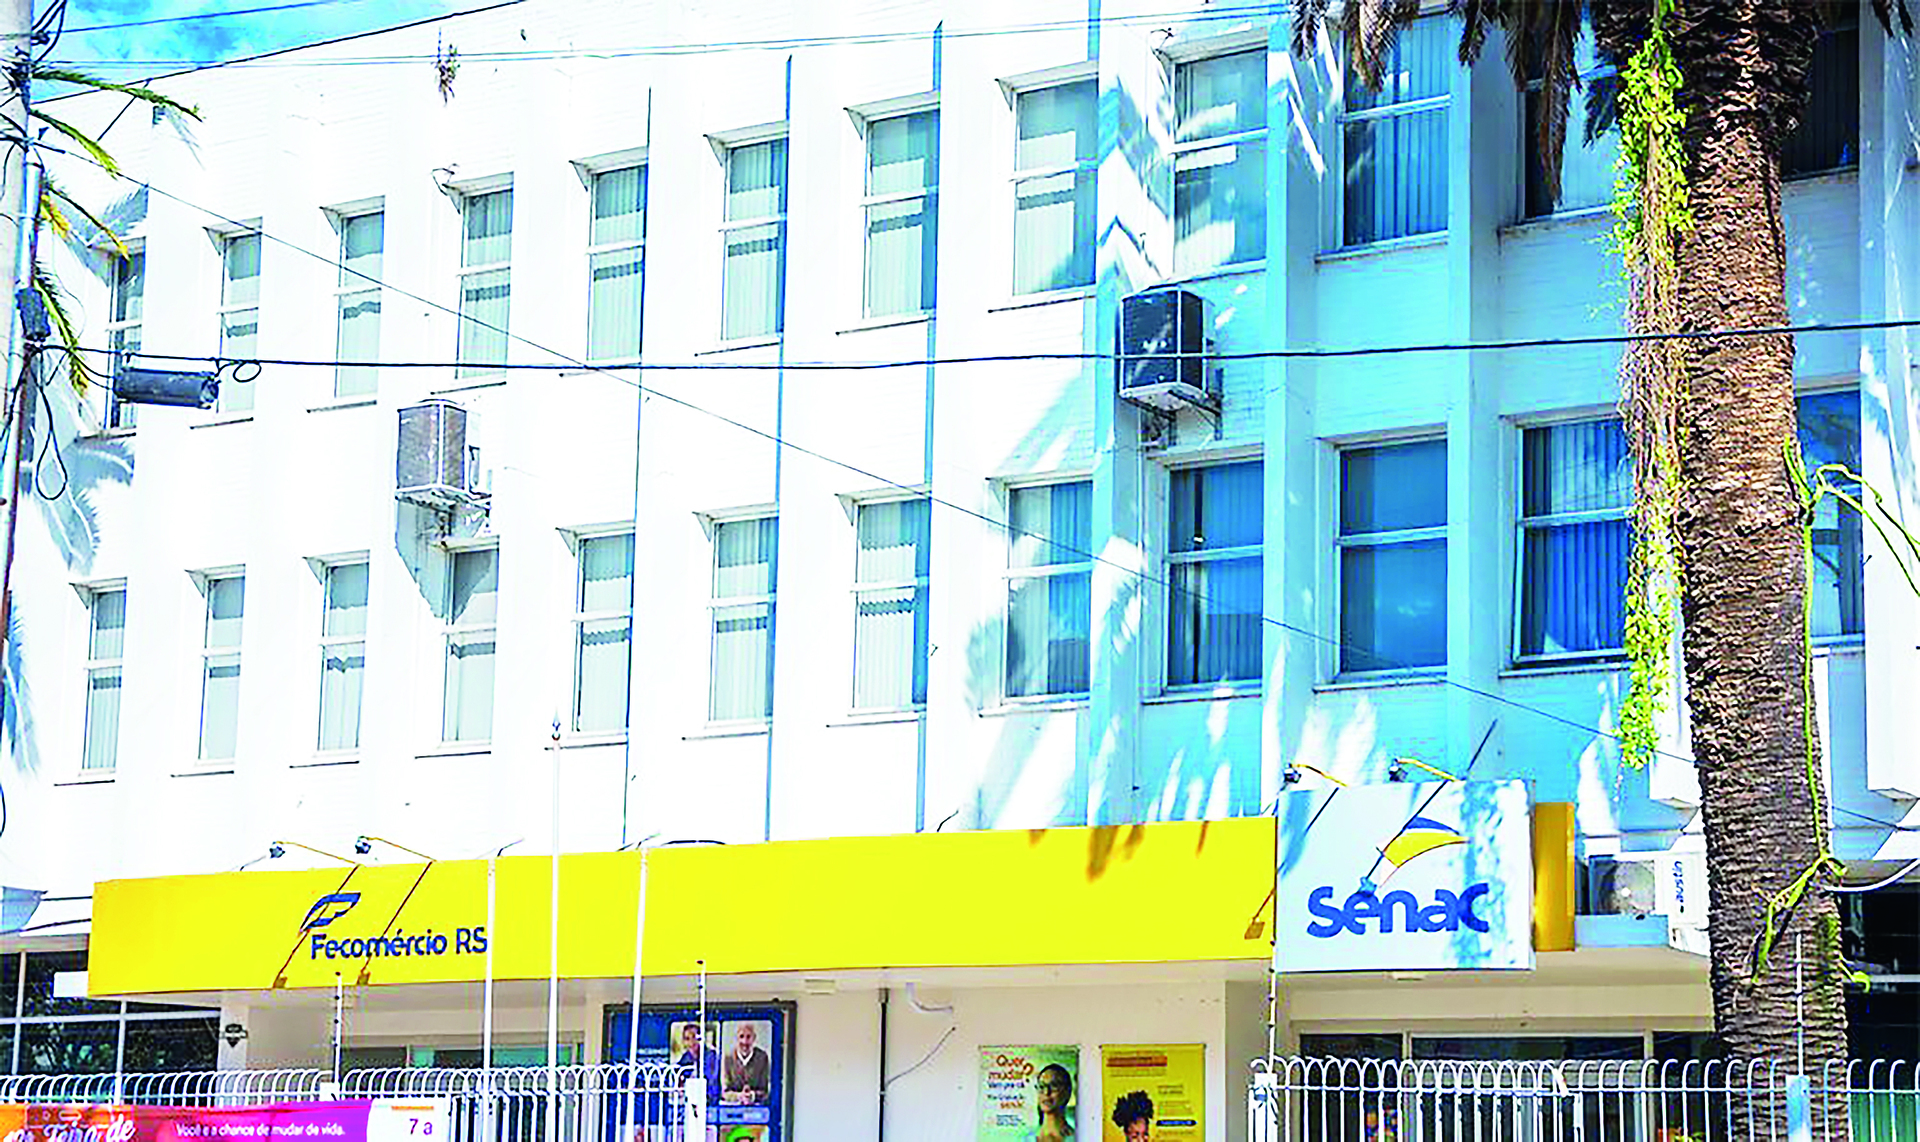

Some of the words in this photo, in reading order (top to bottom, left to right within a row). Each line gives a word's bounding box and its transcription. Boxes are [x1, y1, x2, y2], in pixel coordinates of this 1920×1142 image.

[1307, 882, 1490, 938] Senac
[311, 928, 447, 960] Fecomércio
[456, 926, 488, 954] RS
[106, 1112, 136, 1142] de
[218, 1122, 255, 1137] chance
[256, 1122, 270, 1137] de
[271, 1122, 304, 1137] mudar
[305, 1122, 320, 1137] de
[409, 1118, 419, 1135] 7
[423, 1121, 433, 1136] a
